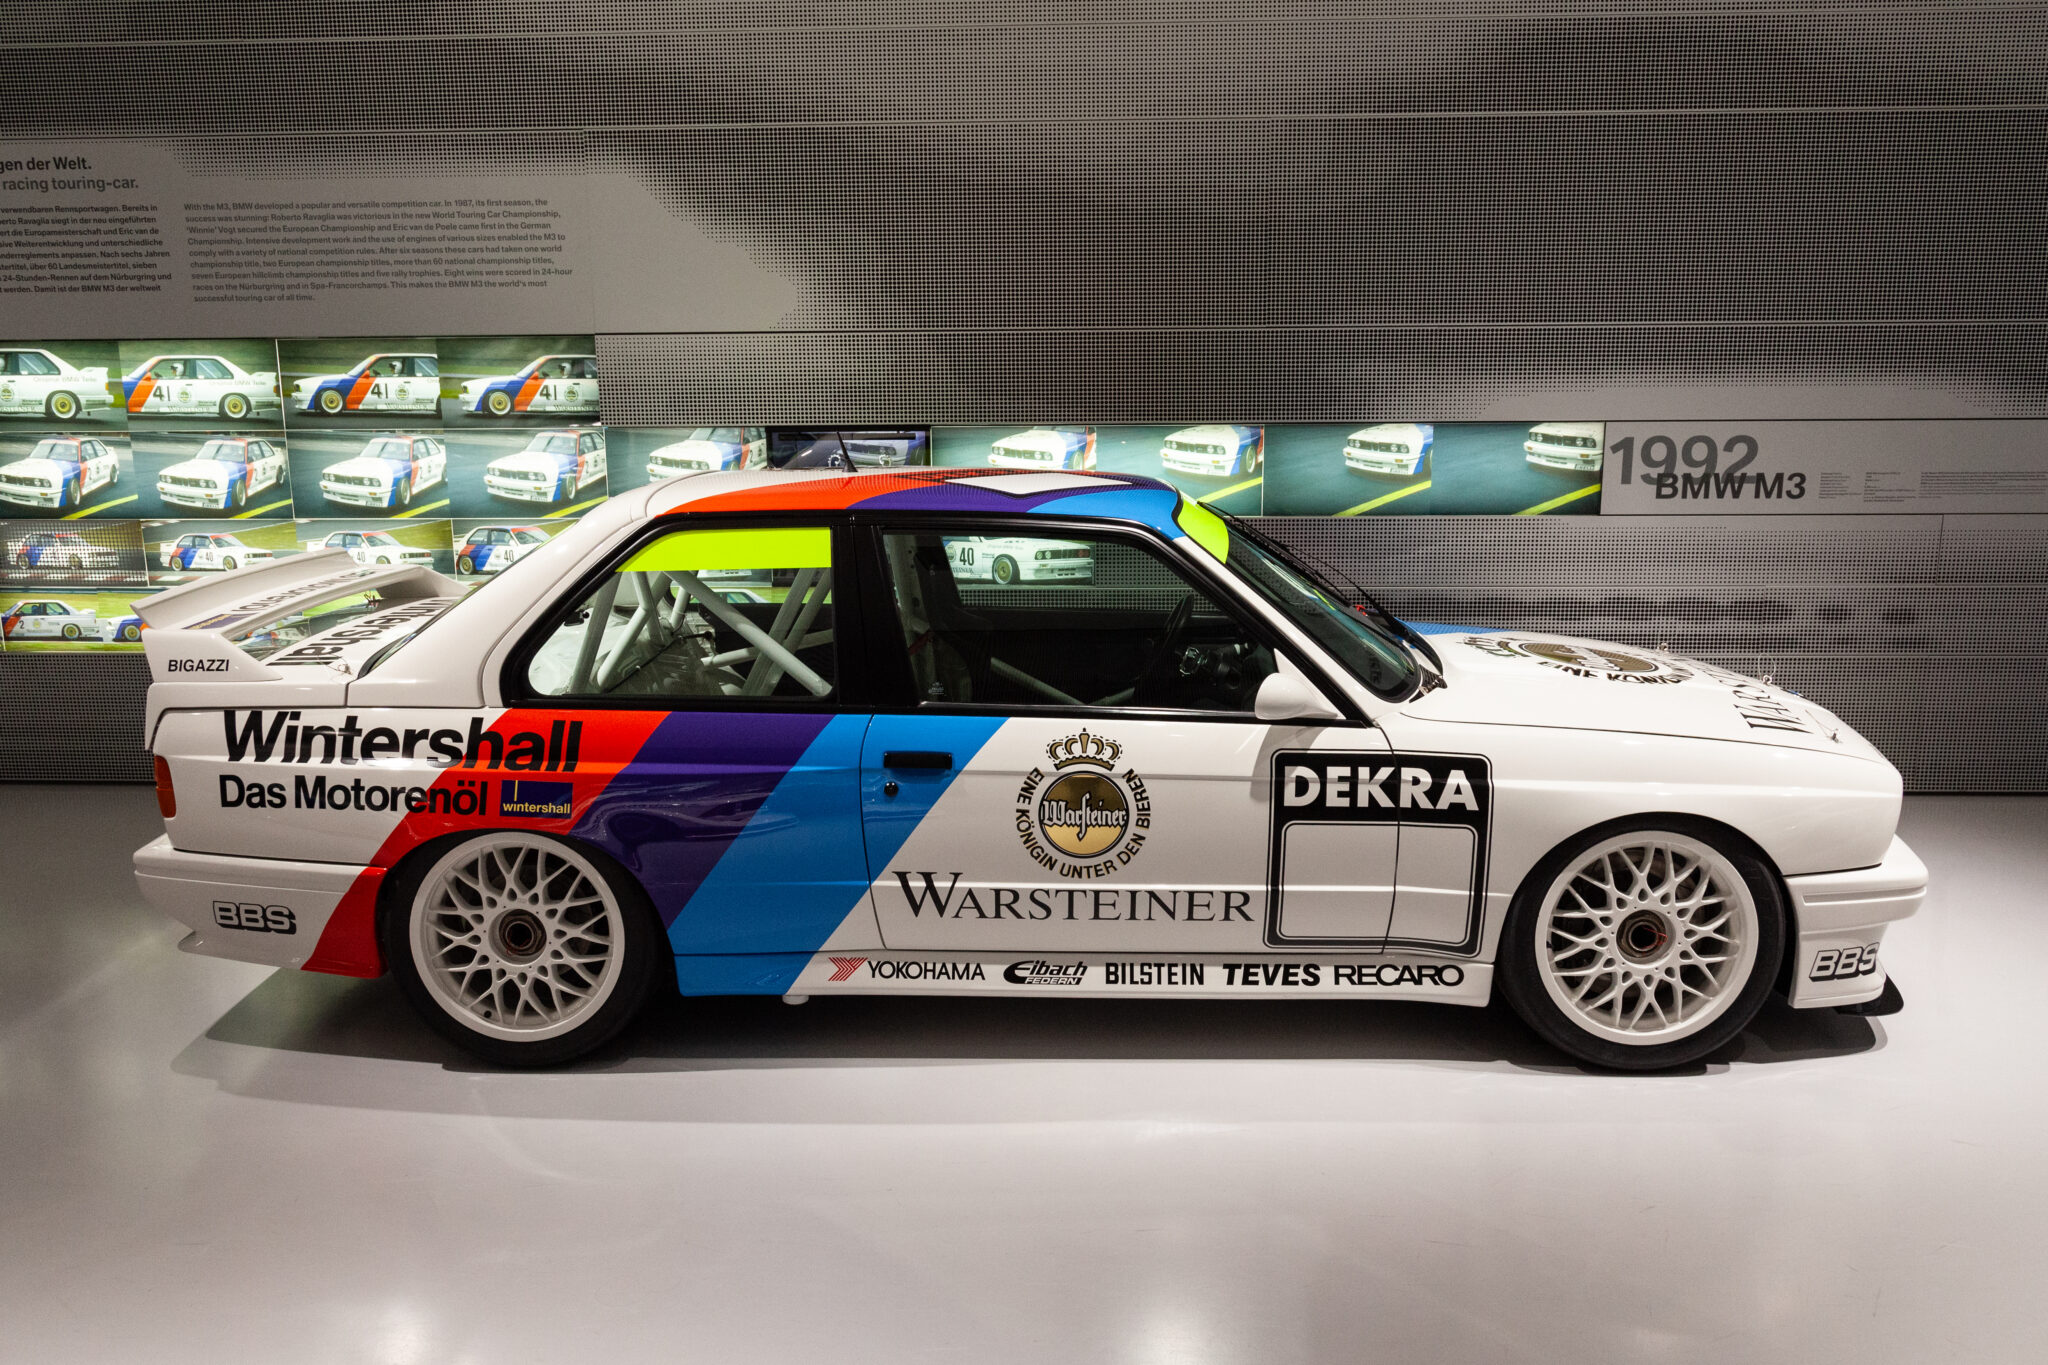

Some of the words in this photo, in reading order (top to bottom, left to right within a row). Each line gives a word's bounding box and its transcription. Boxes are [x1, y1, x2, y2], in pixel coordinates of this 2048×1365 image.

[26, 157, 50, 170] der
[52, 157, 92, 170] Welt.
[2, 177, 48, 192] racing
[52, 176, 139, 192] touring-car.
[122, 205, 149, 213] Bereits
[254, 202, 294, 212] developed
[301, 201, 330, 212] popular
[347, 201, 380, 209] versatile
[382, 200, 428, 210] competition
[18, 217, 50, 227] Ravaglia
[108, 216, 157, 226] eingeführten
[271, 214, 302, 222] Roberto
[303, 213, 336, 224] Ravaglia
[353, 213, 391, 221] victorious
[457, 212, 486, 222] Touring
[24, 228, 102, 239] Europameisterschaft
[237, 225, 268, 234] secured
[282, 225, 319, 235] European
[320, 224, 376, 235] Championship
[520, 223, 552, 231] German
[14, 240, 84, 250] Weiterentwicklung
[100, 239, 163, 248] unterschiedliche
[246, 237, 280, 245] Intensive
[282, 236, 331, 246] development
[406, 235, 437, 245] engines
[446, 235, 475, 243] various
[497, 234, 529, 243] enabled
[144, 250, 171, 259] Jahren
[189, 249, 217, 259] comply
[242, 248, 267, 258] variety
[277, 248, 308, 256] national
[309, 248, 355, 258] competition
[132, 262, 157, 270] sieben
[190, 260, 244, 271] championship
[278, 260, 315, 270] European
[316, 259, 370, 269] championship
[444, 258, 476, 266] national
[477, 257, 532, 268] championship
[2, 274, 79, 283] 24-Stunden-Rennen
[215, 271, 251, 282] European
[252, 271, 284, 280] hillclimb
[286, 271, 340, 281] championship
[340, 270, 360, 279] titles
[505, 269, 532, 277] scored
[542, 269, 573, 277] 24-hour
[129, 284, 162, 293] weltweit
[194, 294, 235, 303] successful
[235, 294, 263, 304] touring
[153, 386, 170, 402] 41
[371, 384, 388, 399] 41
[540, 384, 557, 400] 41
[1610, 434, 1758, 486] 1992
[1656, 472, 1747, 499] BMW
[1754, 472, 1807, 499] M3
[357, 552, 366, 562] 40
[504, 550, 514, 562] 40
[960, 548, 974, 566] 40
[18, 620, 24, 629] 2
[168, 658, 230, 672] BIGAZZI
[224, 710, 583, 772] Wintershall
[1017, 767, 1045, 806] EINE
[1284, 766, 1479, 811] DEKRA
[219, 774, 286, 808] Das
[294, 774, 488, 816] Motorenöl
[1122, 768, 1152, 829] BIEREN
[502, 800, 572, 815] wintershall
[1016, 808, 1058, 872] KÖNIGIN
[1117, 833, 1146, 866] DEN
[1059, 859, 1118, 879] UNTER
[892, 871, 1255, 922] WARSTEINER
[213, 901, 296, 934] BBS
[1809, 942, 1879, 982] BBS
[867, 960, 986, 980] YOKOHAMA
[1003, 960, 1088, 983] Eibach
[1105, 962, 1204, 986] BILSTEIN
[1222, 964, 1320, 986] TEVES
[1334, 964, 1464, 986] RECARO
